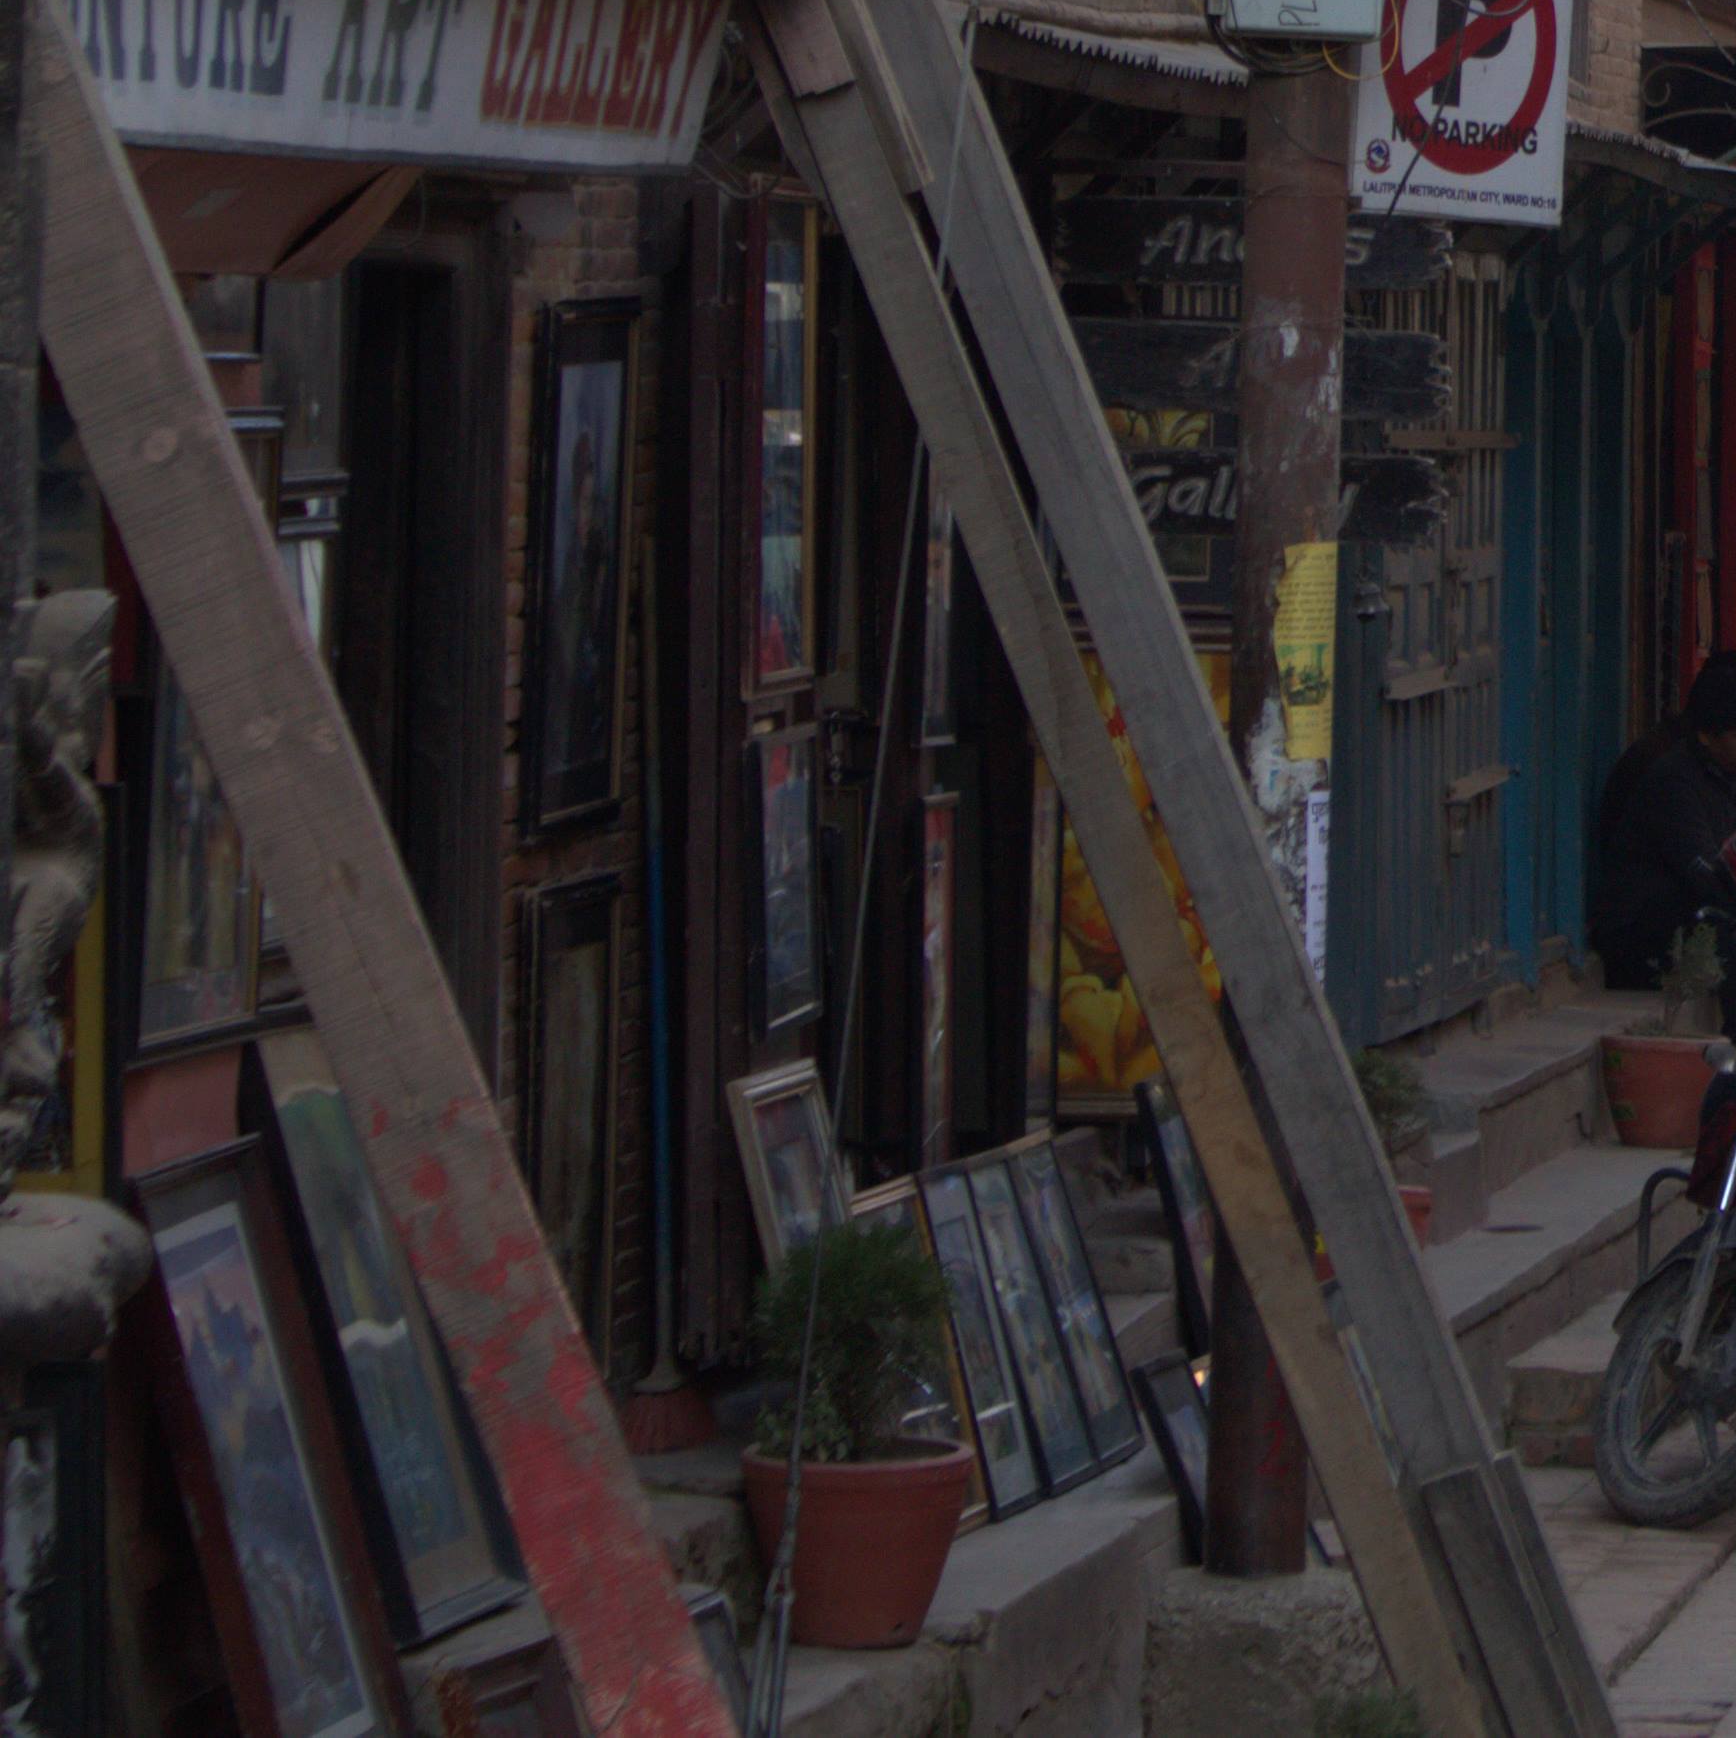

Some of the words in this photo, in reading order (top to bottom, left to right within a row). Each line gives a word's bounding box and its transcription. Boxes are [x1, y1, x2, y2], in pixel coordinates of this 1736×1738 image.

[1392, 114, 1427, 144] NO
[1433, 117, 1538, 155] PARKING
[1408, 182, 1478, 202] METROPOLITAN
[1502, 193, 1530, 207] WARD
